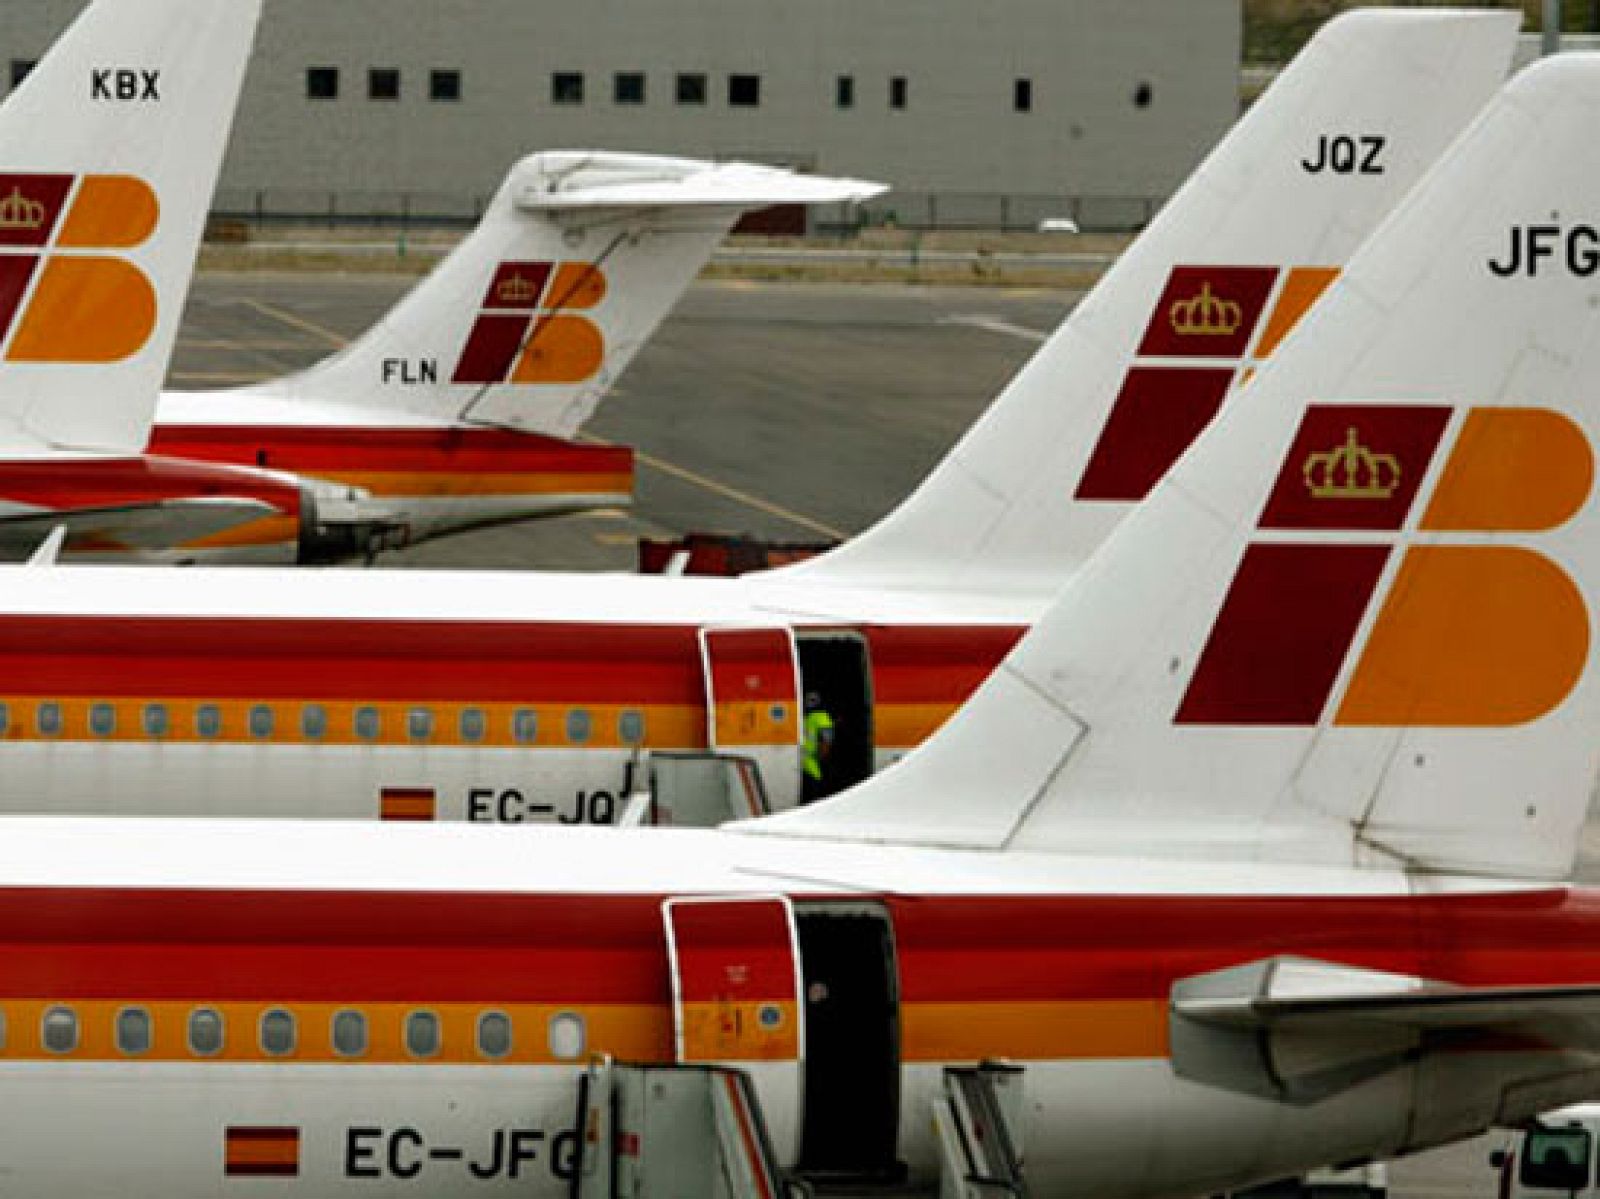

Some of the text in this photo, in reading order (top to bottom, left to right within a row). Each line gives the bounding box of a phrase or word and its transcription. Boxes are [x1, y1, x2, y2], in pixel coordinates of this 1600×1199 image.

[91, 68, 160, 101] KBX
[1301, 135, 1384, 174] JQZ
[1488, 225, 1600, 278] JFG
[382, 358, 437, 384] FLN
[468, 788, 632, 825] EC-JQ
